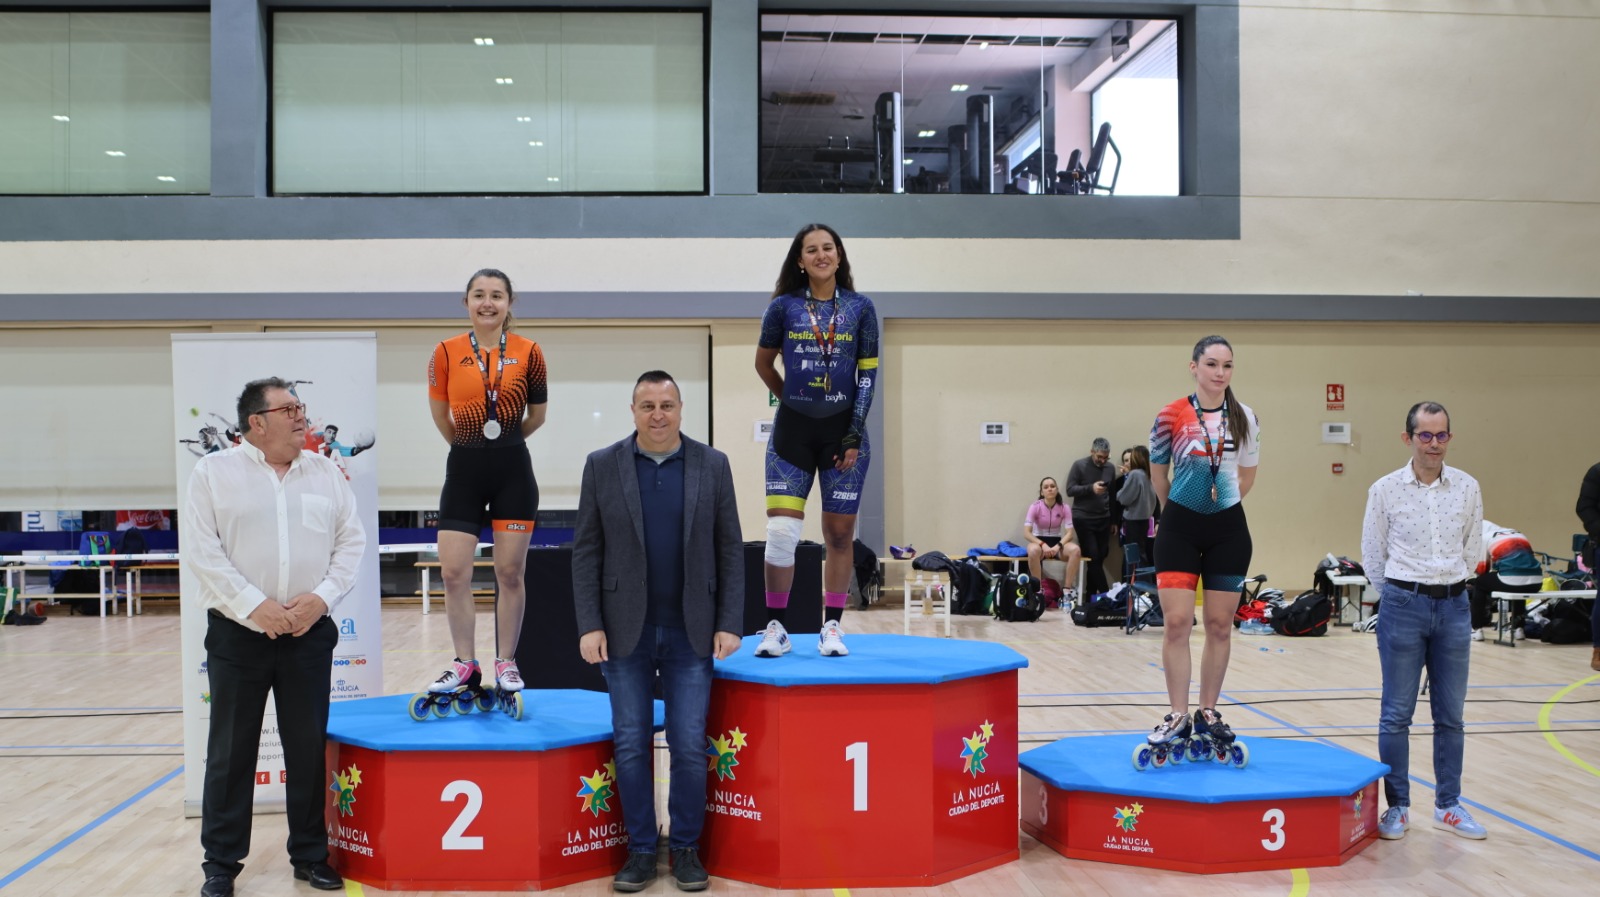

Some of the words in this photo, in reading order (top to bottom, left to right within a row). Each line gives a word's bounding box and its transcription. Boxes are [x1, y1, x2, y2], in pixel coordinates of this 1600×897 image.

[845, 742, 868, 811] 1
[949, 804, 970, 817] CIUDAD
[970, 801, 980, 811] DEL
[980, 794, 1005, 809] DEPORTE
[953, 790, 964, 804] LA
[1039, 785, 1048, 826] 3
[441, 779, 484, 850] 2
[716, 804, 729, 815] DEL
[730, 807, 762, 821] DEPORTE
[568, 830, 582, 844] LA
[1107, 835, 1117, 843] LA
[1261, 808, 1286, 851] 3
[339, 840, 350, 850] DEL
[350, 843, 374, 858] DEPORTE
[562, 844, 589, 857] CIUDAD
[590, 840, 604, 850] DEL
[605, 835, 631, 848] DEPOR
[1131, 846, 1154, 854] DEPORTE
